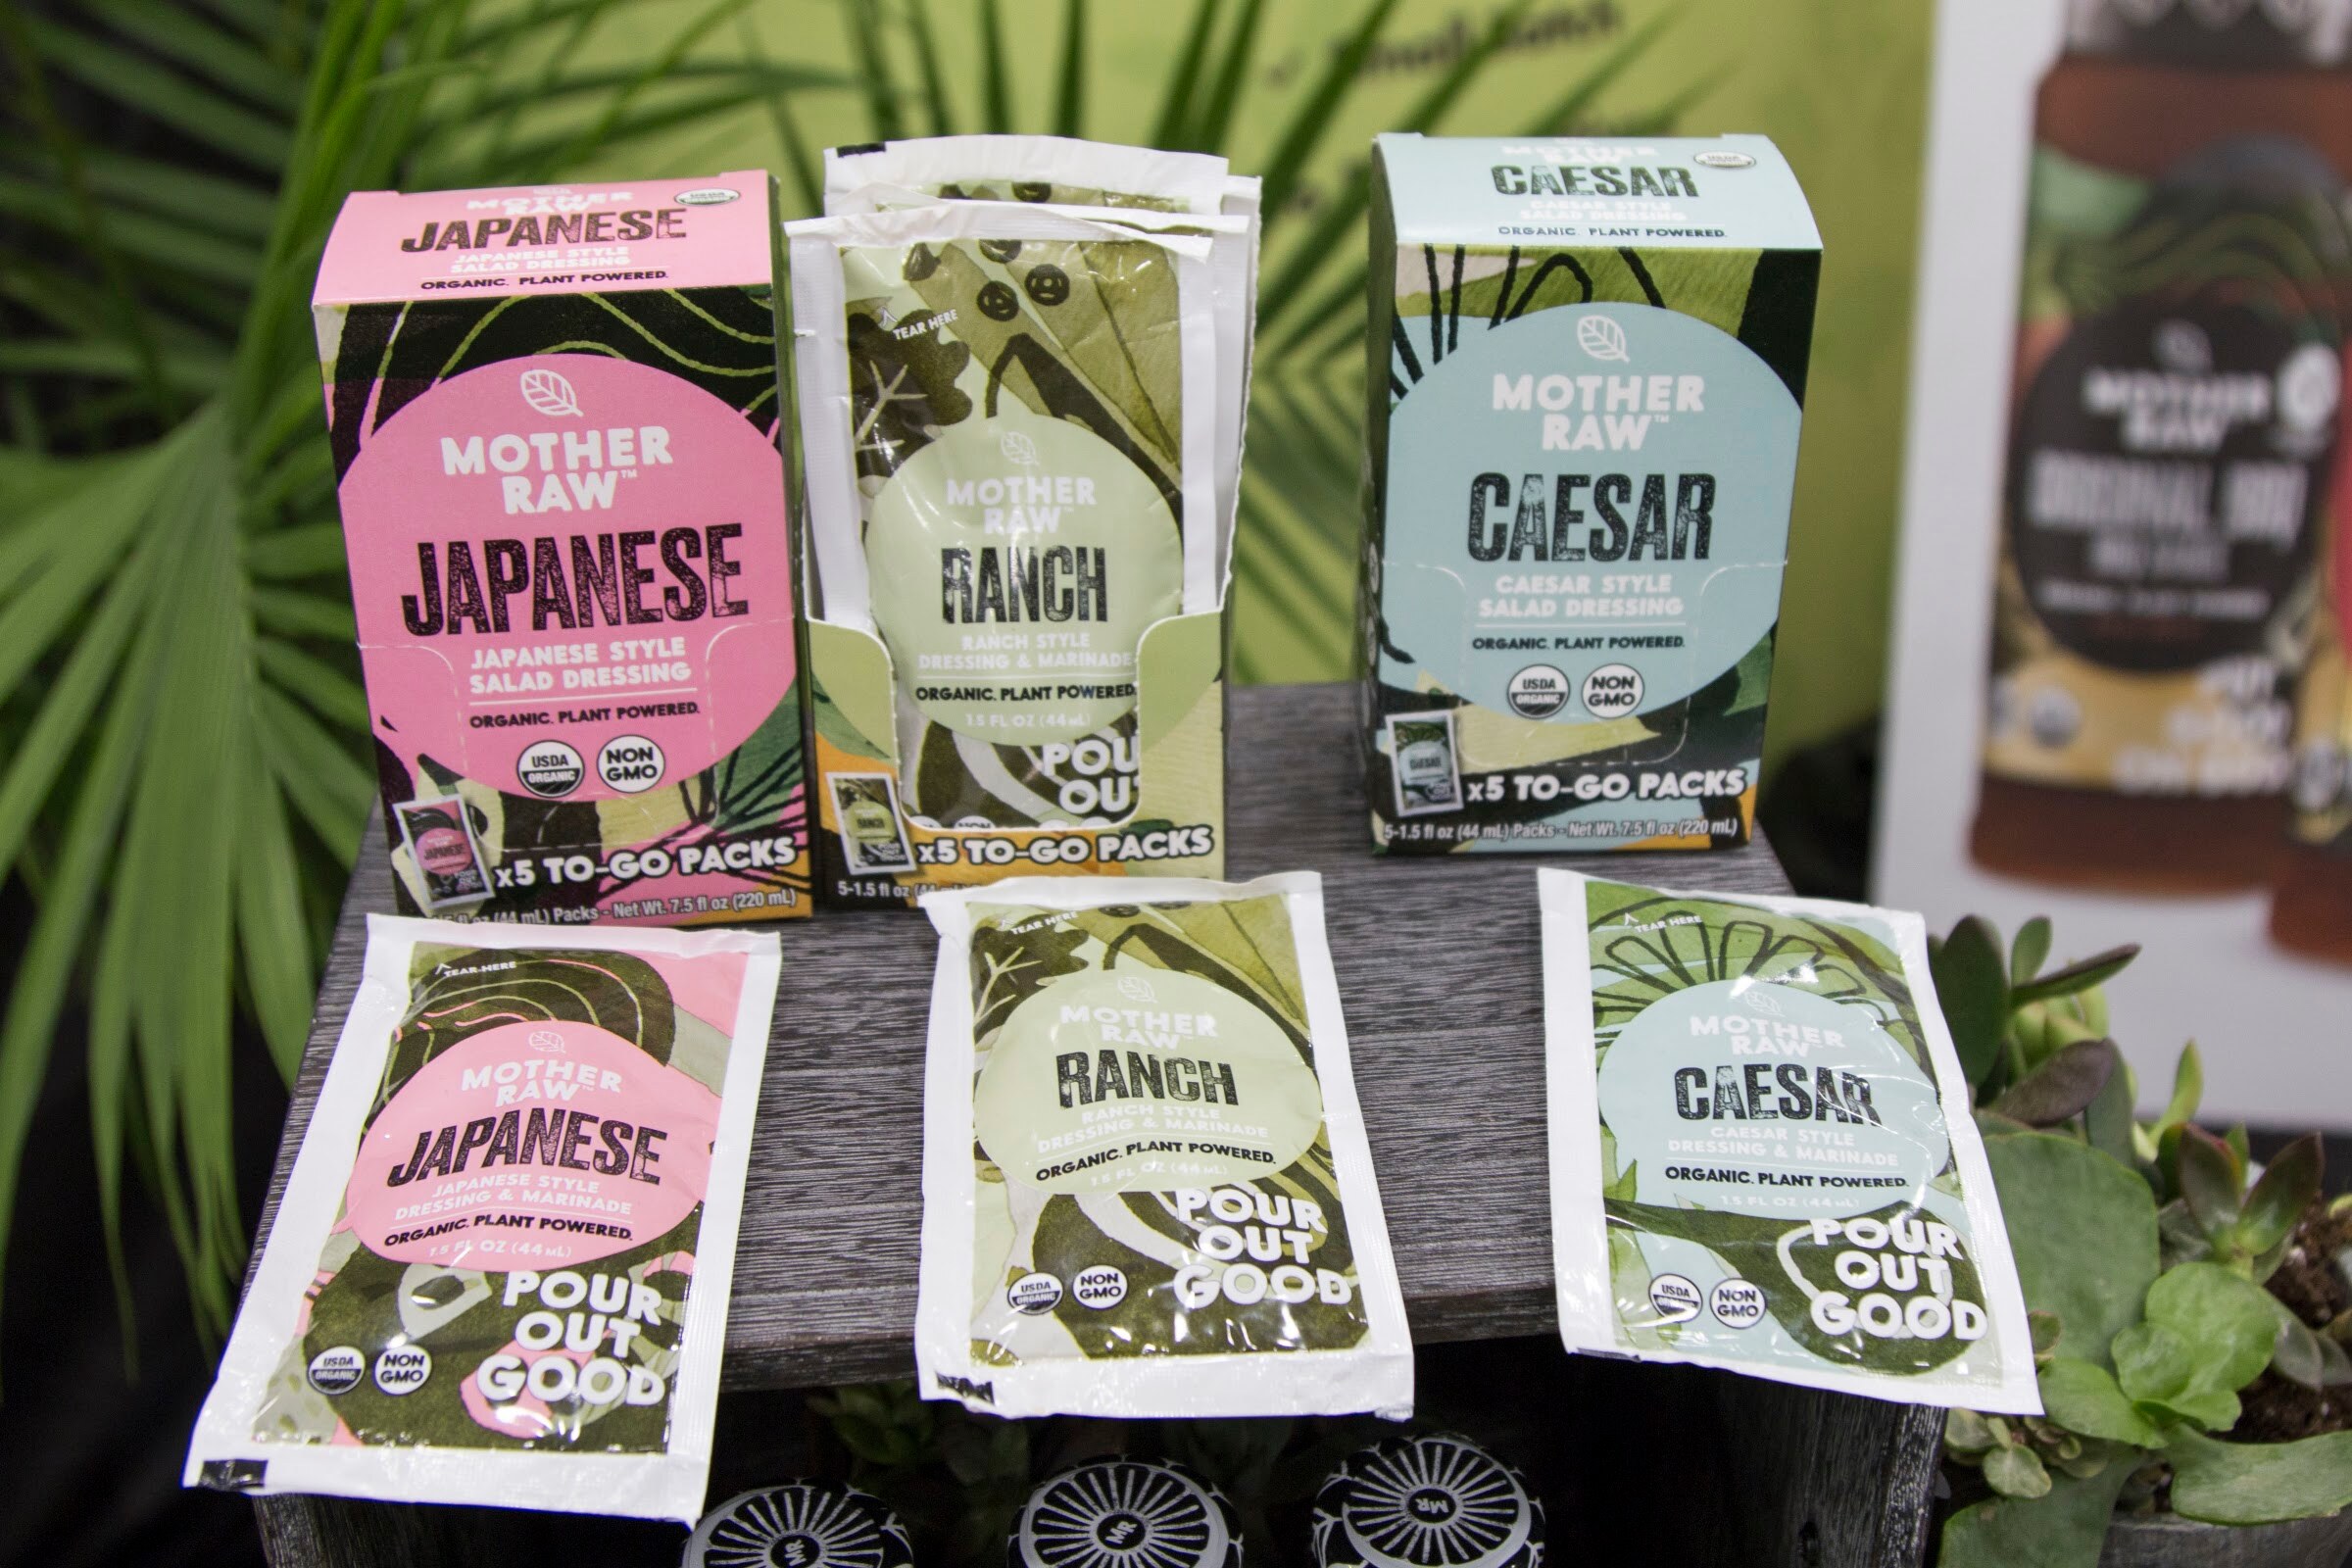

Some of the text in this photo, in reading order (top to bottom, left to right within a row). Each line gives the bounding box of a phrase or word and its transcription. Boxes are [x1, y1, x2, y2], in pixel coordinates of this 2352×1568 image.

[1491, 165, 1700, 197] CAESAR
[401, 208, 687, 252] JAPANESE
[1497, 226, 1727, 238] ORGANIC. PLANT POWERED.
[450, 256, 631, 273] SALAD DRESSING
[457, 246, 630, 265] JAPANESE STYLE
[420, 270, 668, 290] ORGANIC. PLANT POWERED.
[892, 309, 958, 340] TEAR HERE
[1493, 373, 1705, 412] MOTHER
[440, 425, 673, 475] MOTHER
[946, 476, 1097, 506] MOTHER
[1467, 471, 1717, 563] CAESAR
[400, 522, 750, 637] JAPANESE
[941, 545, 1107, 623] RANCH
[1494, 574, 1672, 594] CAESAR STYLE
[1478, 597, 1685, 617] SALAD DRESSING
[471, 637, 686, 669] JAPANESE STYLE
[961, 632, 1091, 651] RANCH STYLE
[1472, 636, 1686, 650] ORGANIC. PLANT POWERED.
[917, 652, 1133, 670] DRESSING & MARINADE
[469, 662, 692, 694] SALAD DRESSING
[1522, 678, 1556, 690] USDA
[1591, 676, 1635, 690] NON
[915, 683, 1138, 702] ORGANIC. PLANT POWERED.
[1516, 694, 1560, 705] ORGANIC
[1588, 693, 1636, 707] GMO
[469, 702, 701, 728] ORGANIC. PLANT POWERED.
[532, 754, 569, 768] USDA
[606, 747, 654, 764] NON
[1042, 736, 1139, 777] POU
[526, 769, 576, 784] ORGANIC
[606, 764, 659, 782] GMO
[1467, 775, 1504, 802] x5
[1512, 773, 1631, 801] TO-GO
[1639, 769, 1745, 799] PACKS
[1059, 776, 1139, 813] OU
[1385, 824, 1420, 839] 5-1.5
[1437, 828, 1453, 839] oz
[1457, 824, 1479, 841] (44
[1483, 823, 1509, 841] mL)
[1512, 823, 1554, 838] Packs
[1568, 822, 1593, 836] Net
[1596, 821, 1618, 836] Wt.
[1622, 821, 1642, 836] 7.5
[1659, 823, 1676, 835] oz
[1679, 819, 1708, 838] (220
[1711, 818, 1738, 836] mL)
[918, 839, 957, 863] x5
[967, 838, 1090, 863] TO-GO
[1099, 827, 1212, 862] PACKS
[495, 859, 536, 888] x5
[543, 849, 671, 884] TO-GO
[677, 836, 796, 874] PACKS
[838, 881, 875, 897] 5-1.5
[893, 887, 909, 897] oz
[553, 889, 797, 923] Packs Net Wt. 7.5 fl oz (220 mL)
[1011, 911, 1079, 935] TEAR HERE
[1635, 915, 1702, 934] TEAR HERE
[443, 961, 516, 978] TEAR HERE
[1060, 1005, 1218, 1037] MOTHER
[1690, 1015, 1846, 1048] MOTHER
[461, 1058, 622, 1094] MOTHER
[1055, 1049, 1240, 1108] RANCH
[1674, 1063, 1883, 1127] CAESAR
[1081, 1104, 1221, 1125] RANCH STYLE
[387, 1107, 667, 1188] JAPANESE
[1037, 1118, 1269, 1153] DRESSING & MARINADE
[1710, 1126, 1855, 1147] CAESAR STYLE
[1036, 1141, 1277, 1181] ORGANIC. PLANT POWERED.
[1668, 1140, 1898, 1167] DRESSING & MARINADE
[432, 1173, 601, 1199] JAPANESE STYLE
[1665, 1165, 1910, 1188] ORGANIC. PLANT POWERED.
[395, 1189, 632, 1221] DRESSING & MARINADE
[1175, 1188, 1328, 1234] POUR
[384, 1213, 633, 1247] ORGANIC. PLANT POWERED.
[1810, 1217, 1963, 1260] POUR
[1198, 1225, 1314, 1264] OUT
[1080, 1273, 1118, 1286] NON
[1835, 1250, 1949, 1294] OUT
[503, 1270, 662, 1326] POUR
[1015, 1293, 1056, 1304] ORGANIC
[1020, 1281, 1052, 1293] USDA
[1079, 1286, 1122, 1299] GMO
[1172, 1262, 1352, 1309] GOOD
[1661, 1284, 1690, 1298] USDA
[1718, 1289, 1756, 1302] NON
[1717, 1303, 1759, 1318] GMO
[1811, 1291, 1988, 1341] GOOD
[514, 1310, 641, 1359] OUT
[323, 1356, 354, 1367] USDA
[384, 1354, 425, 1367] NON
[379, 1369, 424, 1384] GMO
[476, 1353, 665, 1406] GOOD
[1415, 1497, 1449, 1513] MR
[1104, 1520, 1139, 1545] MR
[784, 1539, 808, 1567] MR
